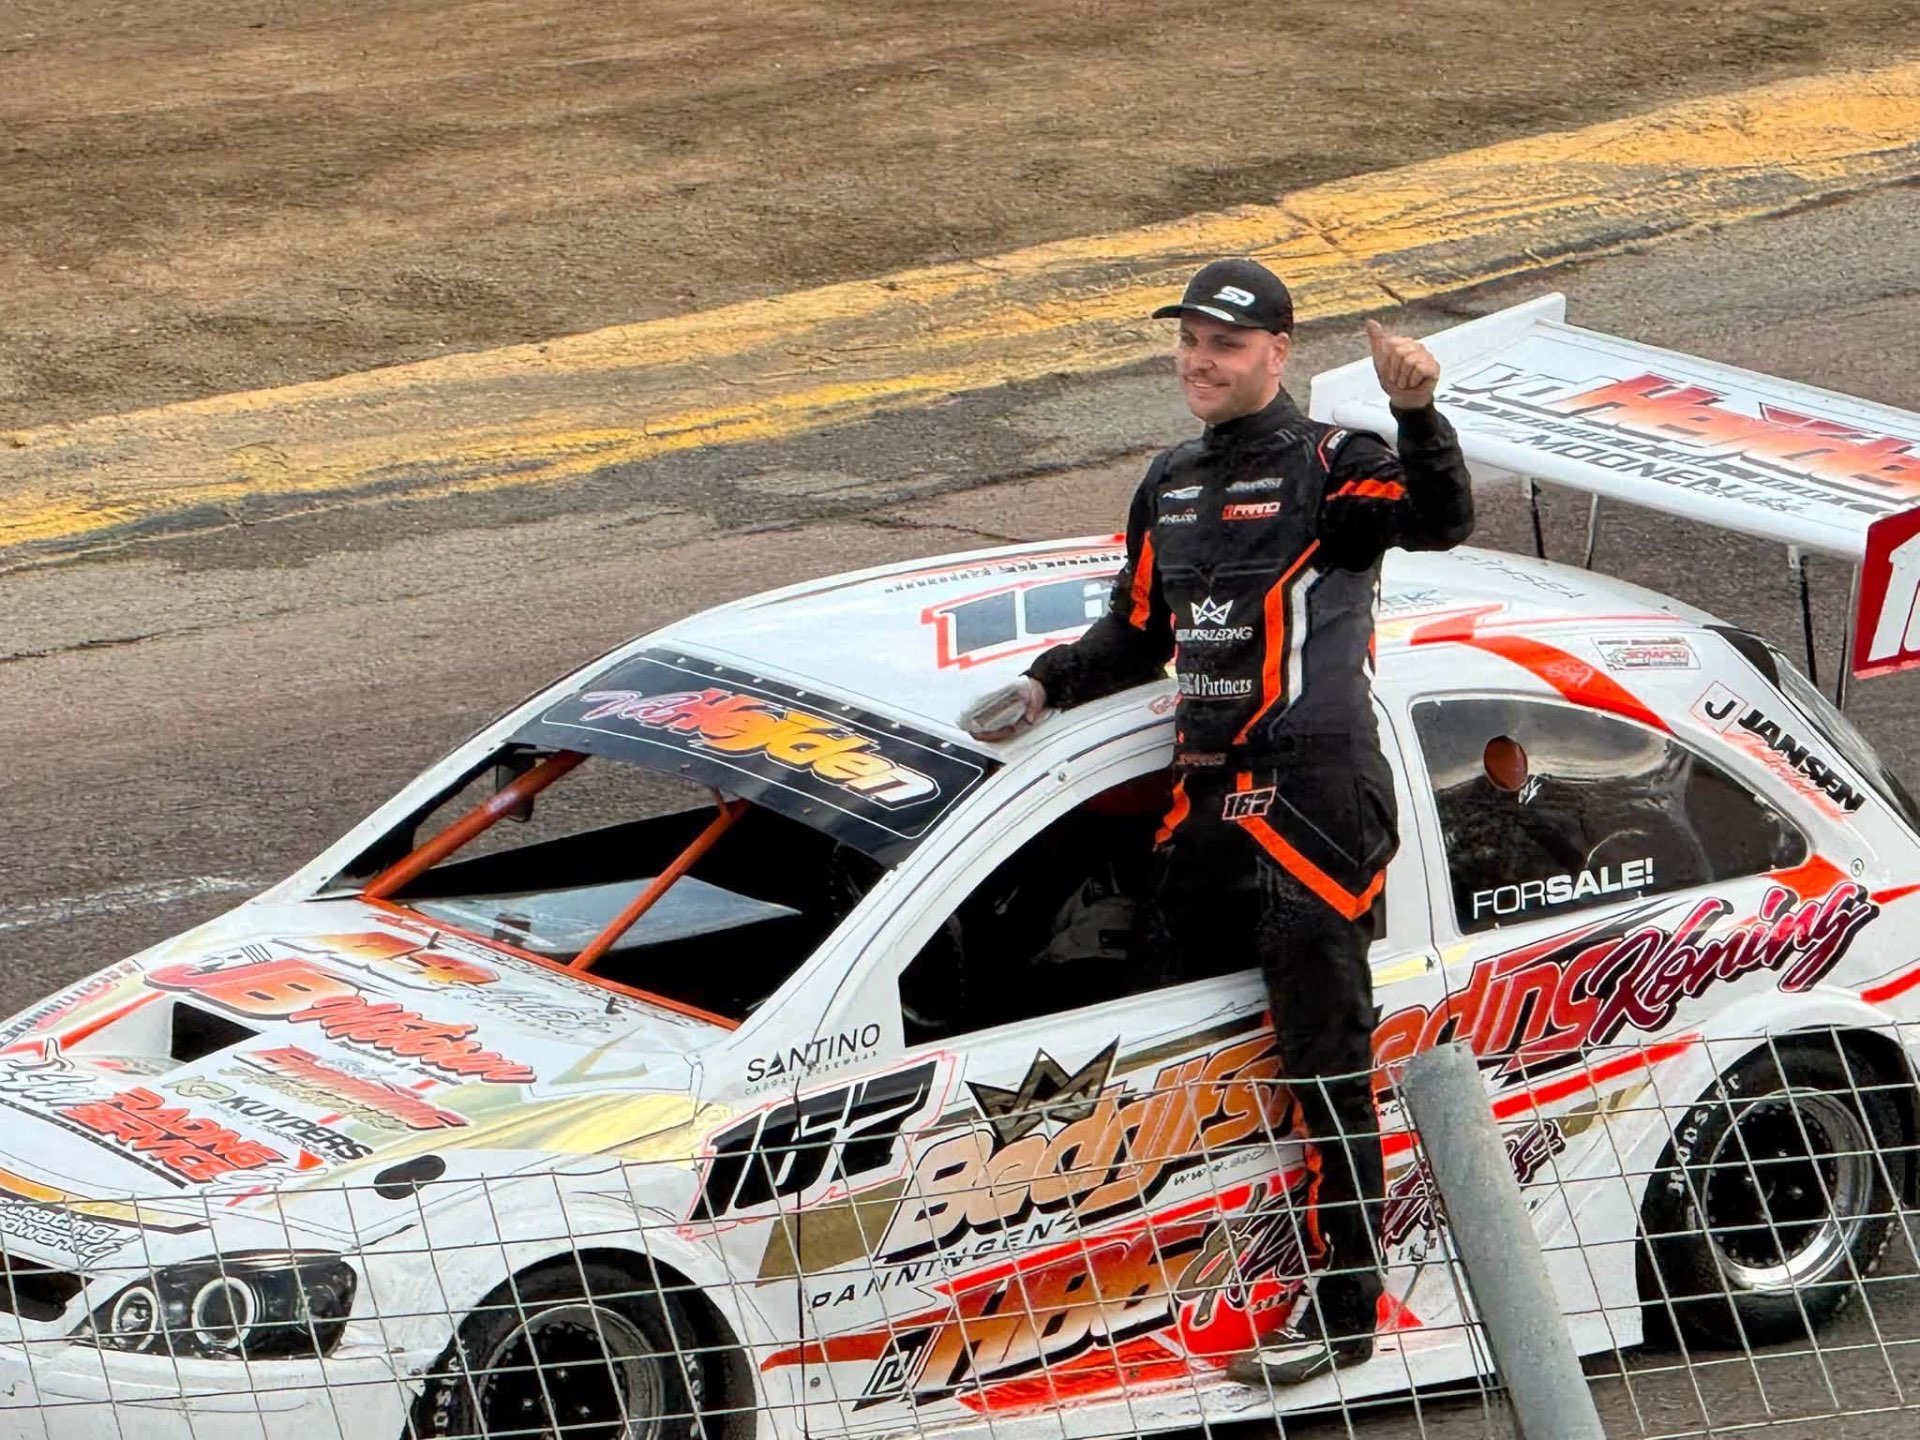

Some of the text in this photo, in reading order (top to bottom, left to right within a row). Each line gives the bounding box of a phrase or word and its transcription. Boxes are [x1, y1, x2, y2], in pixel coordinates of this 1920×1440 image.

[1867, 531, 1920, 663] 1
[1704, 699, 1738, 721] J
[1737, 708, 1867, 812] JANSEN
[1588, 879, 1880, 1047] Koning
[747, 1023, 881, 1082] SANTINO
[53, 1102, 238, 1184] SERVICE
[216, 1095, 375, 1161] KUYPERS
